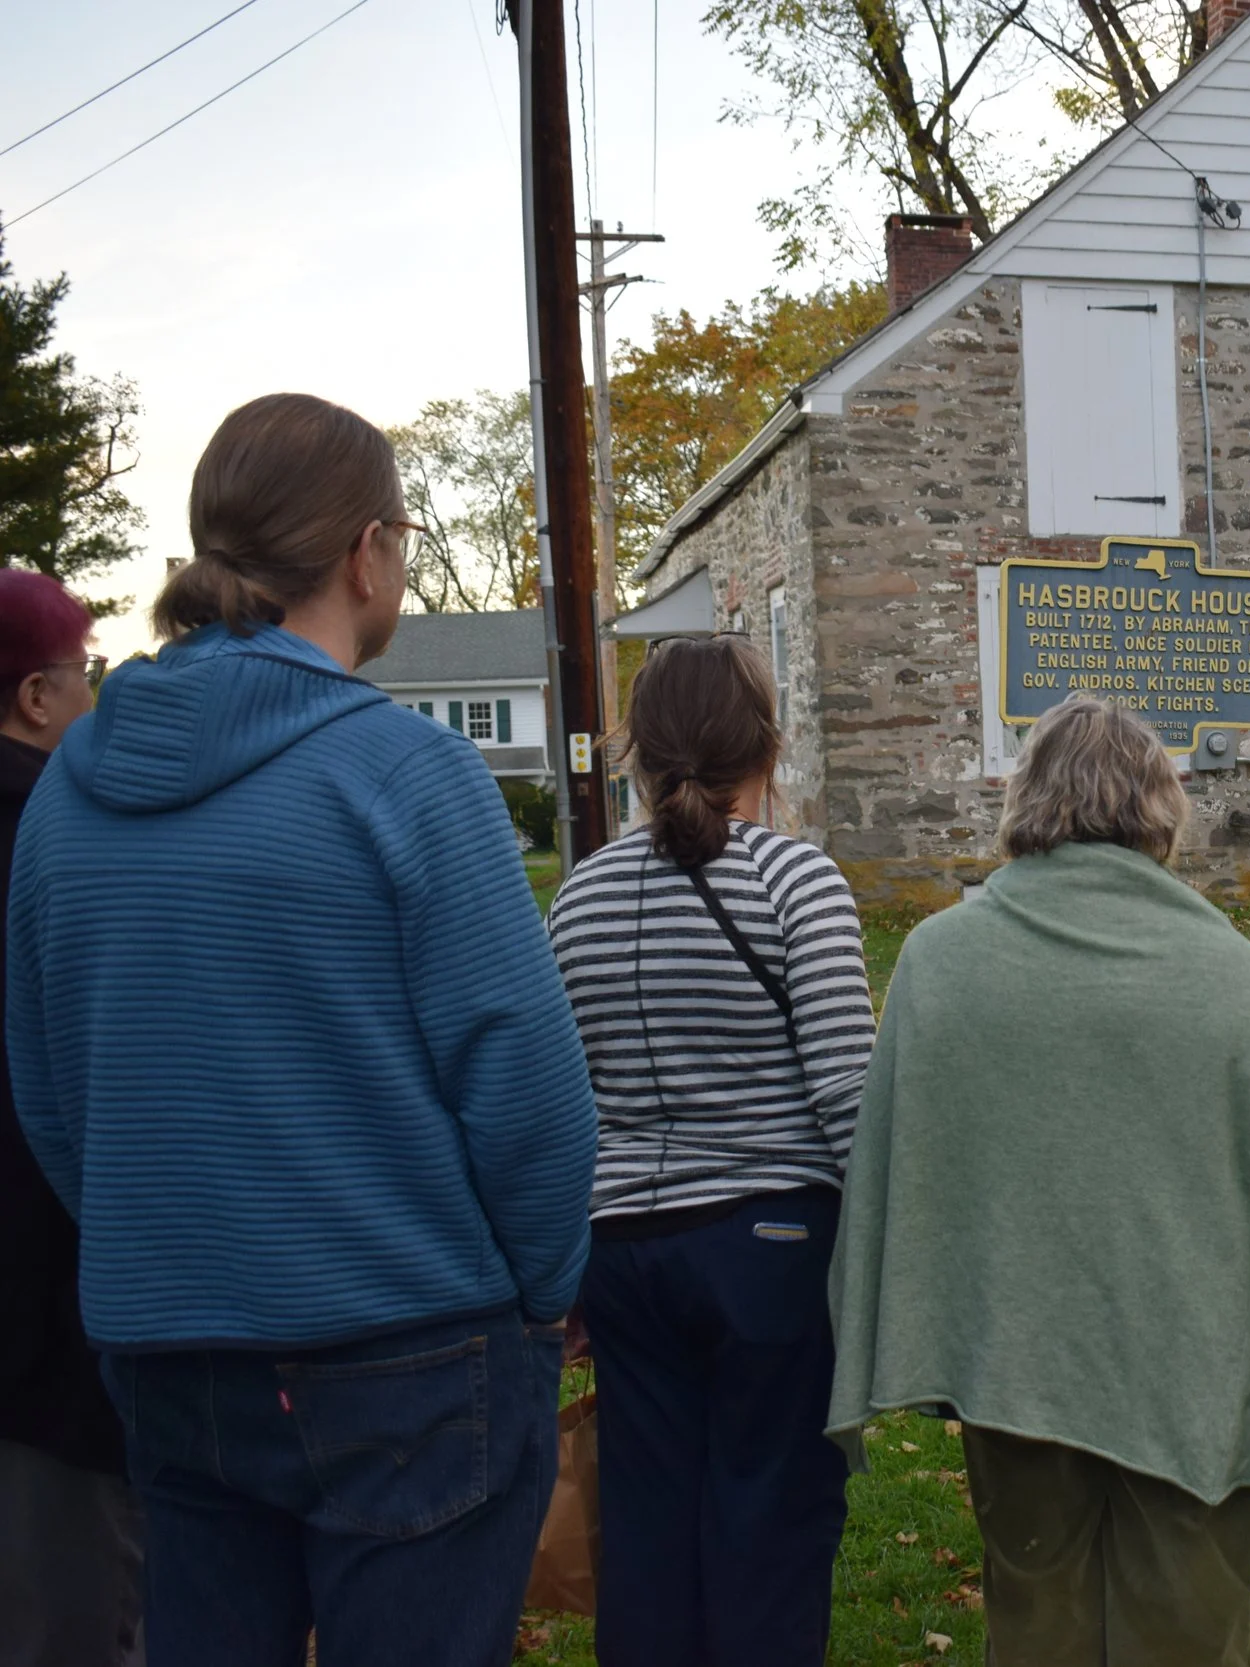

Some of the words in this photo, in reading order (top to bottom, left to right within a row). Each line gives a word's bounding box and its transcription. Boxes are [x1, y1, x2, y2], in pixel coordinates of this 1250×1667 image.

[1113, 558, 1131, 566] NEW
[1168, 560, 1190, 568] YORK
[1018, 582, 1181, 613] HASBROUCK
[1025, 611, 1072, 629] BUILT
[1080, 614, 1117, 632] 1712,
[1124, 615, 1146, 631] BY
[1152, 617, 1234, 635] ABRAHAM,
[1029, 632, 1118, 651] PATENTEE,
[1124, 636, 1167, 652] ONCE
[1174, 637, 1242, 654] SOLDIER
[1037, 652, 1107, 669] ENGLISH
[1115, 655, 1164, 672] ARMY,
[1172, 657, 1230, 673] FRIEND
[1023, 672, 1060, 688] GOV.
[1068, 674, 1140, 690] ANDROS.
[1147, 676, 1215, 692] KITCHEN
[1157, 696, 1219, 712] FIGHTS.
[1143, 720, 1188, 730] DUCATION
